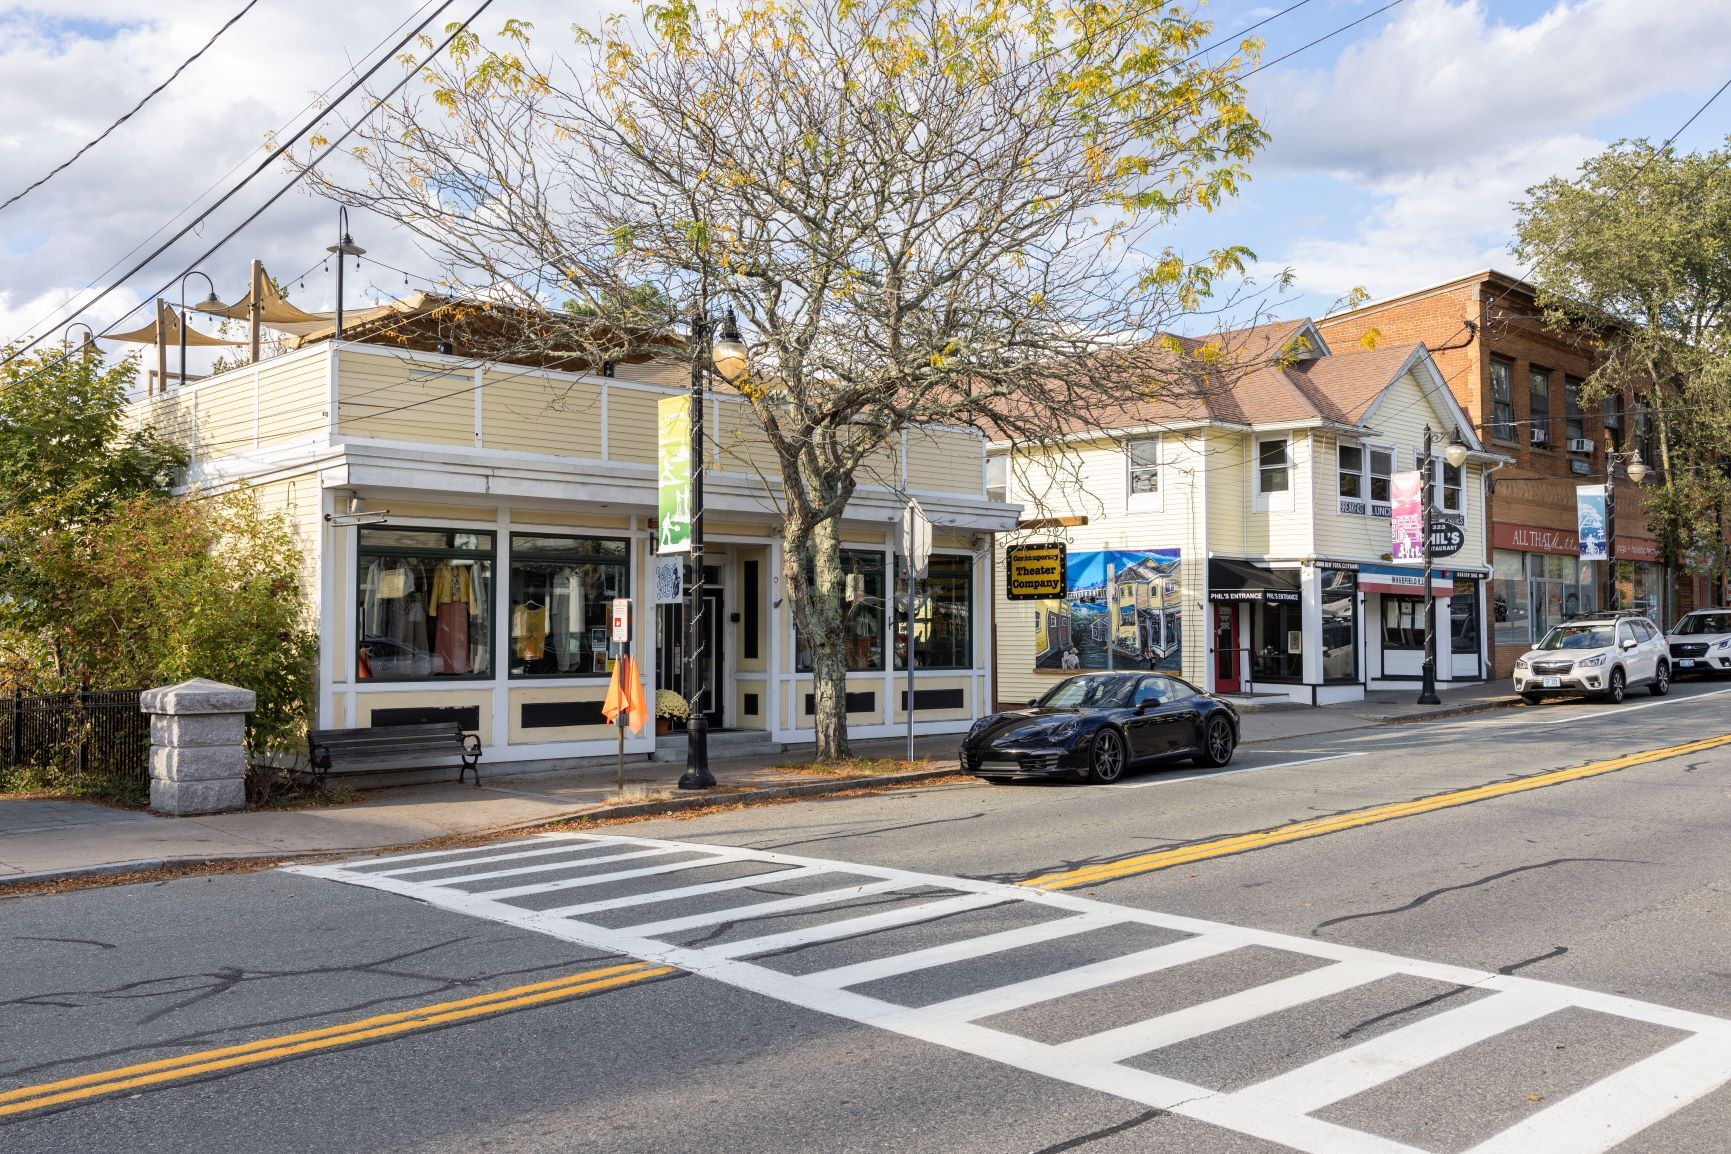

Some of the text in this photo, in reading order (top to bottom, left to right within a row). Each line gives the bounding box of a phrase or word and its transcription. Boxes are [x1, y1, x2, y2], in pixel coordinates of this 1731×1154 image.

[1430, 531, 1460, 545] HIL'S
[1512, 530, 1529, 546] ALL
[1529, 531, 1551, 547] THAT
[1016, 565, 1056, 576] Theater
[1012, 579, 1060, 590] Company
[1230, 592, 1263, 600] ENTRANCE
[1266, 592, 1299, 601] PHIL'S ENTRANCE
